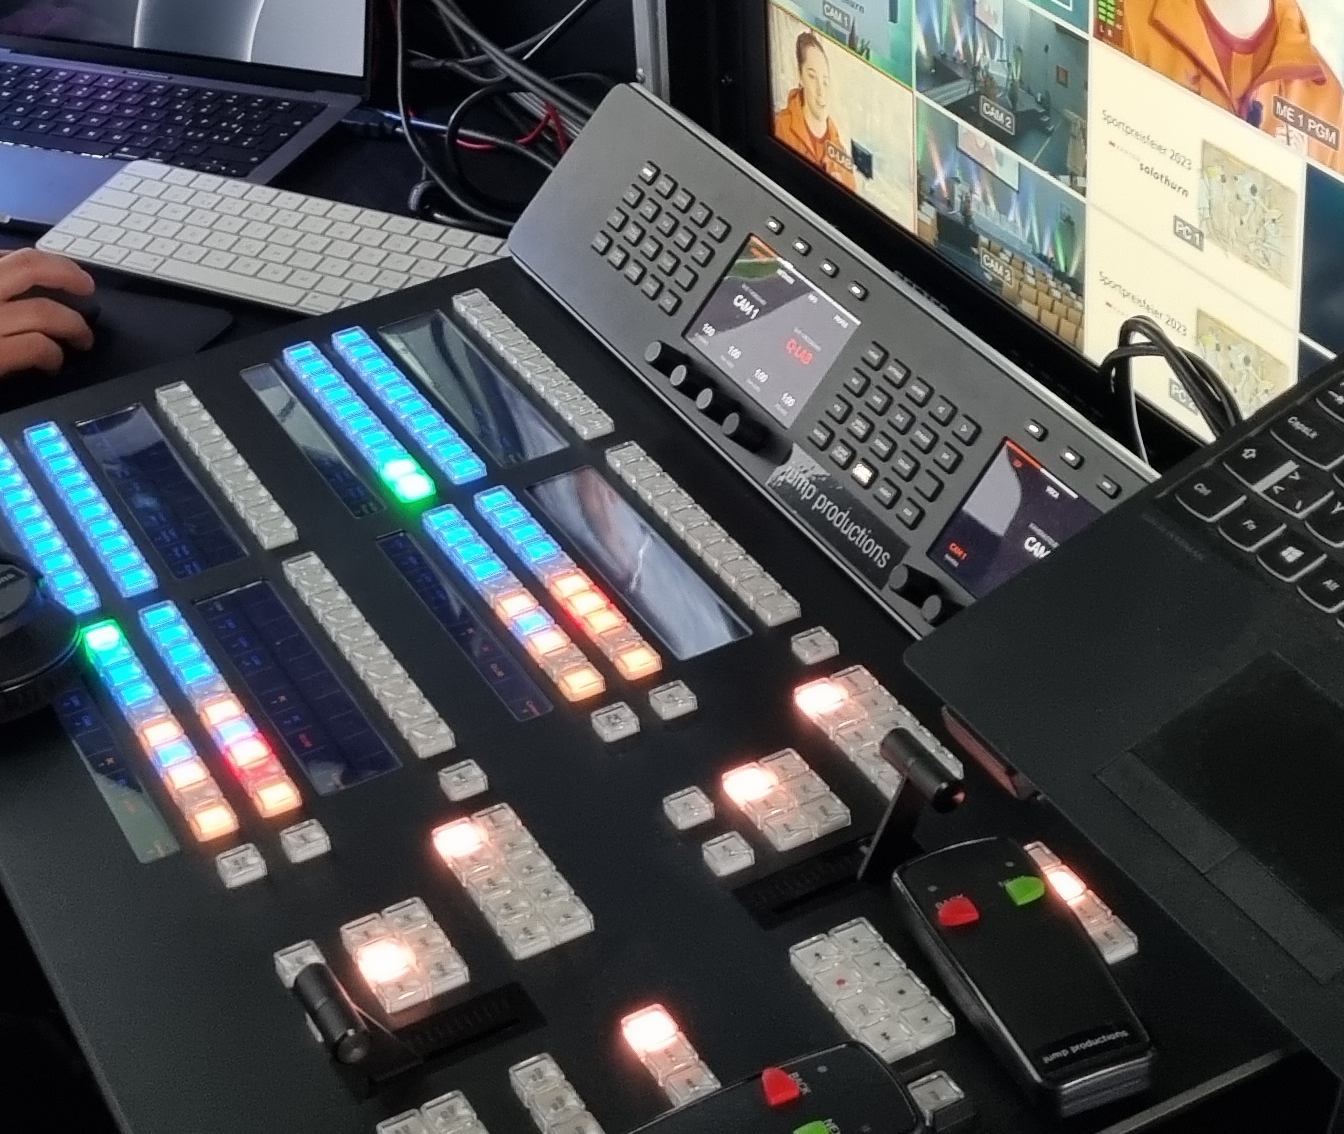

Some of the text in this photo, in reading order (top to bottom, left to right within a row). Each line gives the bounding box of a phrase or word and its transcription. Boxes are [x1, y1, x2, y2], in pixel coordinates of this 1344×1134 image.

[824, 3, 843, 22] CAM
[983, 102, 1012, 127] CAM 2
[1275, 99, 1296, 122] ME
[1307, 115, 1337, 145] PGM
[1102, 109, 1193, 171] Sportpreisfeier 2023
[1139, 162, 1189, 197] solothurn
[1175, 219, 1194, 241] PC
[983, 253, 1003, 277] CAM
[733, 295, 754, 315] CAM
[1165, 313, 1188, 337] 2023
[1171, 383, 1188, 402] PC
[784, 464, 891, 570] jump productions
[1043, 1030, 1129, 1064] jump productions
[789, 1071, 812, 1095] BACK
